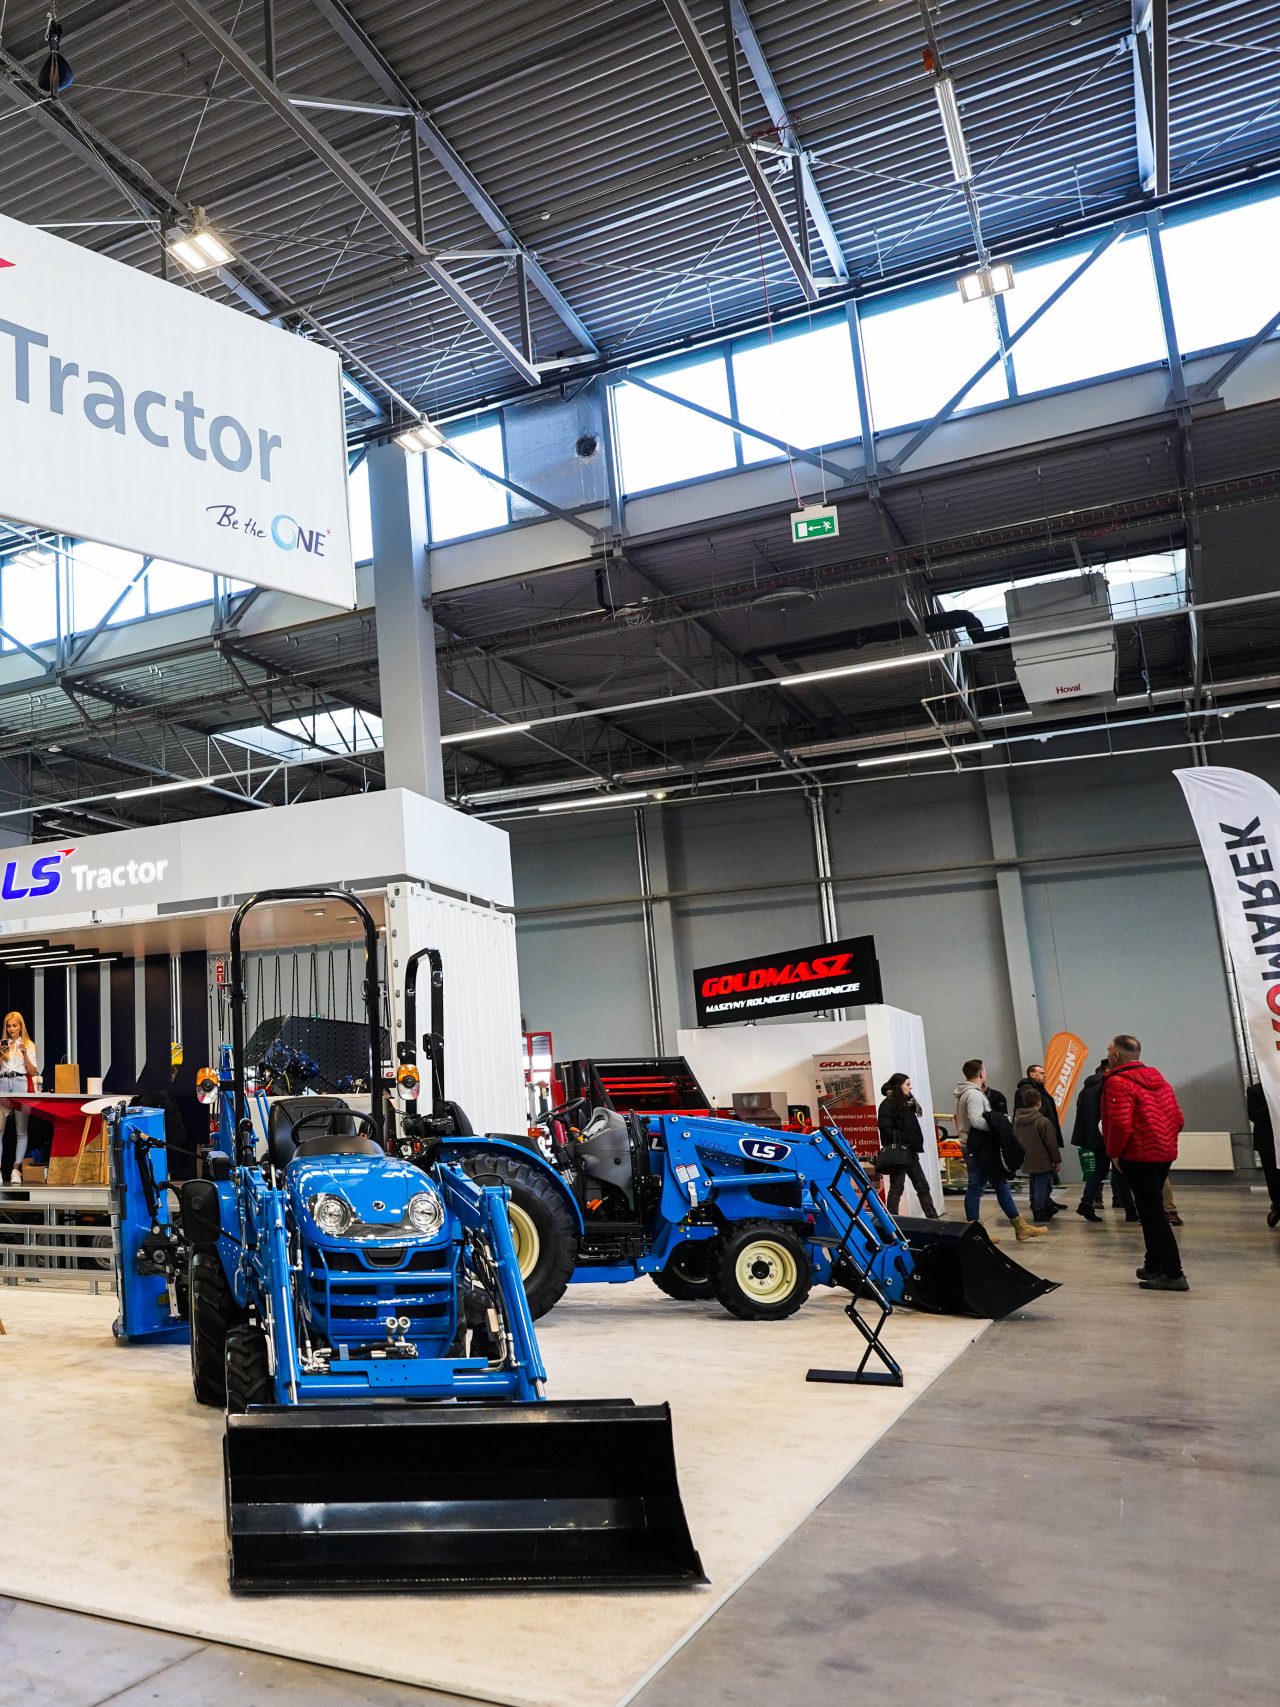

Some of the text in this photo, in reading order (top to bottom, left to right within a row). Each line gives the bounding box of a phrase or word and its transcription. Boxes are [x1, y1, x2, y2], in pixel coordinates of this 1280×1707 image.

[206, 504, 326, 557] Be the ONE
[1056, 683, 1081, 694] Hoval
[1, 855, 168, 900] LS Tractor
[701, 953, 854, 997] GOLDMASZ
[705, 999, 746, 1013] MASZYNY
[746, 993, 790, 1007] ROLNICZE
[795, 983, 861, 999] OGRODNICZE
[752, 1143, 776, 1159] LS
